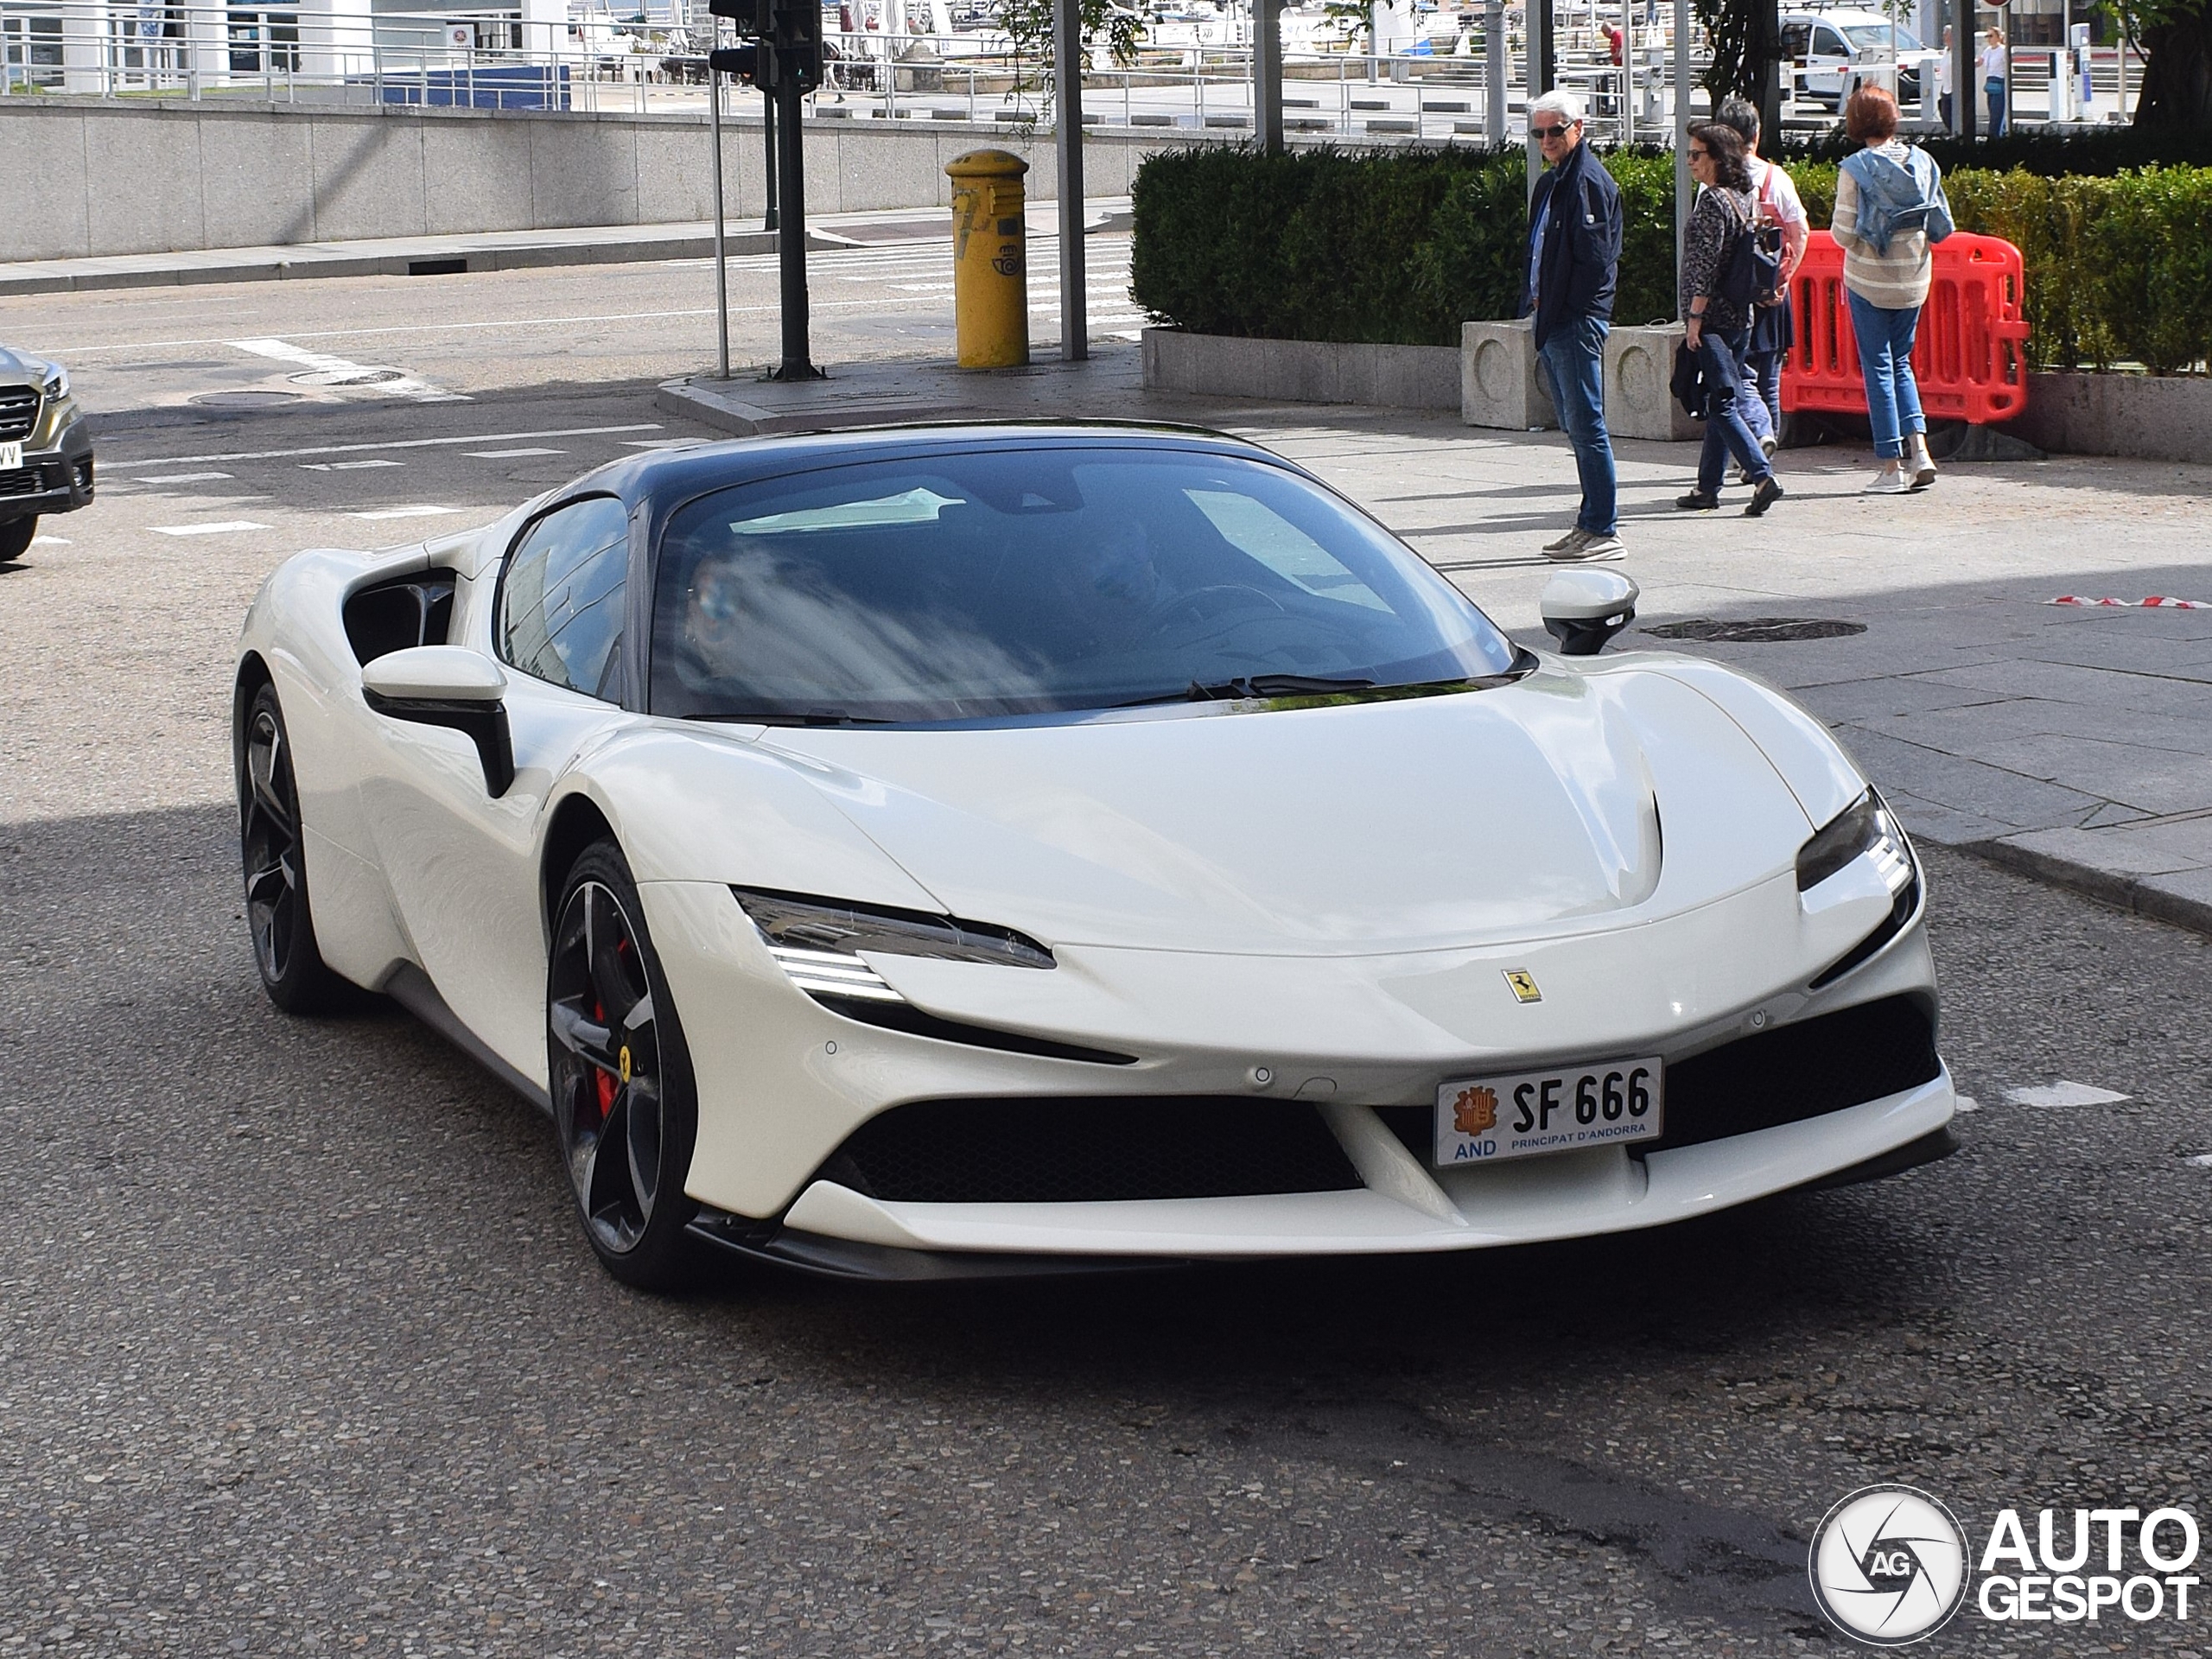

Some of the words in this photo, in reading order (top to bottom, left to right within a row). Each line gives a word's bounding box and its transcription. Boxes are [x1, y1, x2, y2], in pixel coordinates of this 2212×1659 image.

[1512, 1078, 1562, 1133] SF
[1575, 1067, 1649, 1125] 666
[1454, 1140, 1497, 1160] AND
[1511, 1133, 1573, 1150] PRINCIPAT
[1578, 1123, 1646, 1141] D'ANDORRA
